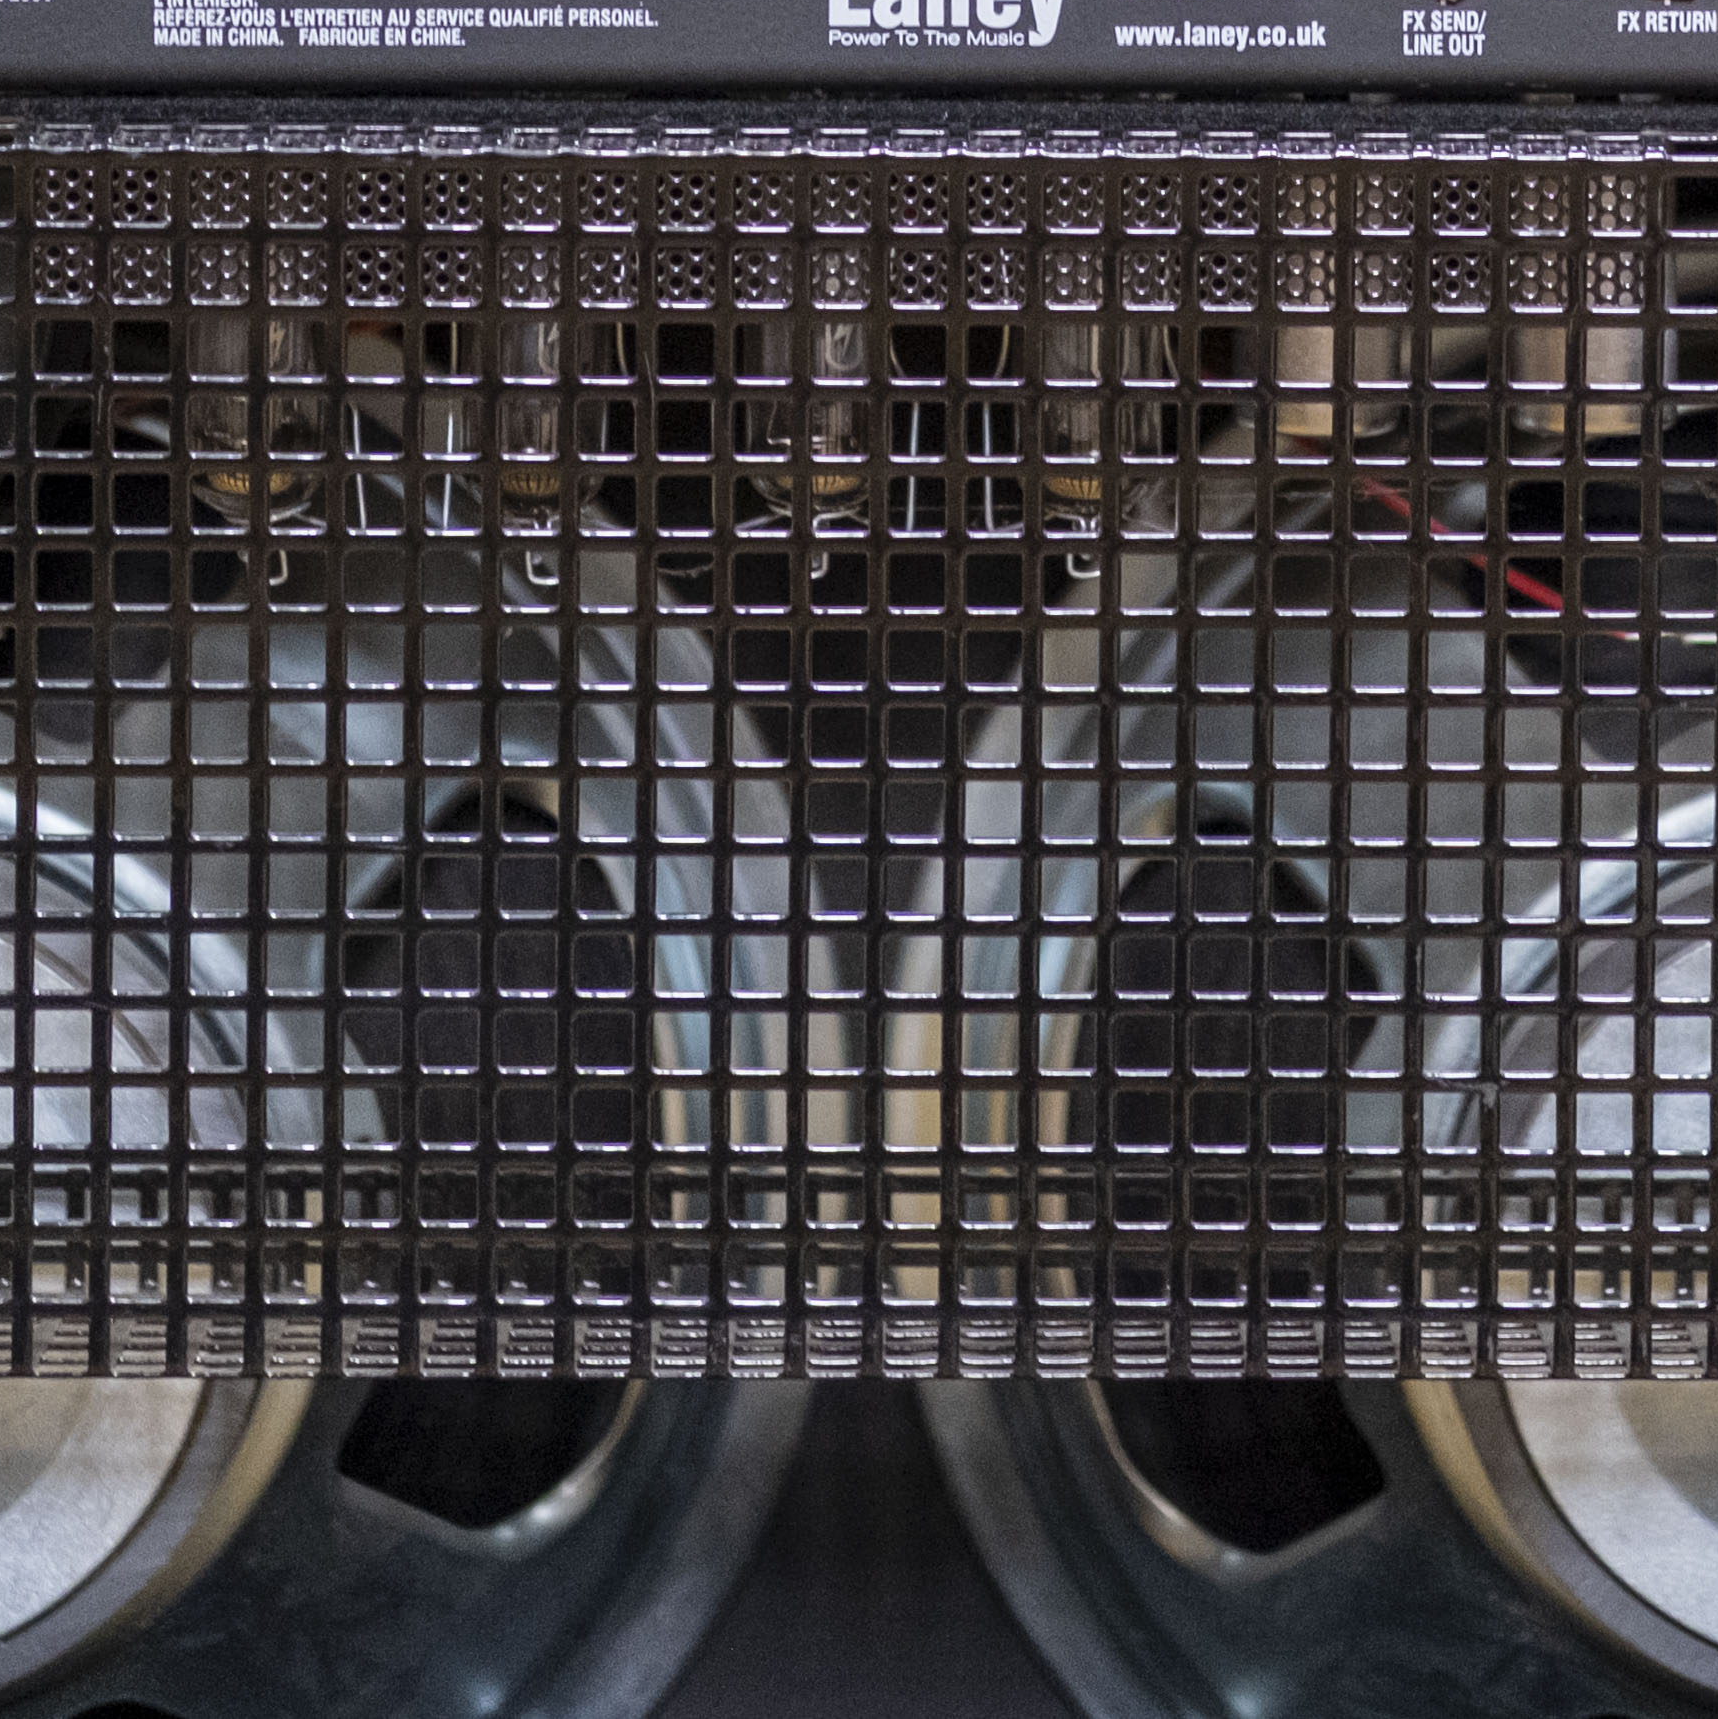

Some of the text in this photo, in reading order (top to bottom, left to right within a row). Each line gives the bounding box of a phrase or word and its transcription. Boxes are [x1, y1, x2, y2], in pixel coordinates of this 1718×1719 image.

[1403, 11, 1487, 34] FX SEND/
[1617, 11, 1718, 34] FX RETURN
[153, 28, 465, 46] MADE IN CHINA. FABRIQUE EN CHINE.
[828, 30, 1024, 47] Power To The Music
[1114, 22, 1326, 51] www.laney.co.uk
[1403, 34, 1486, 57] LINE OUT
